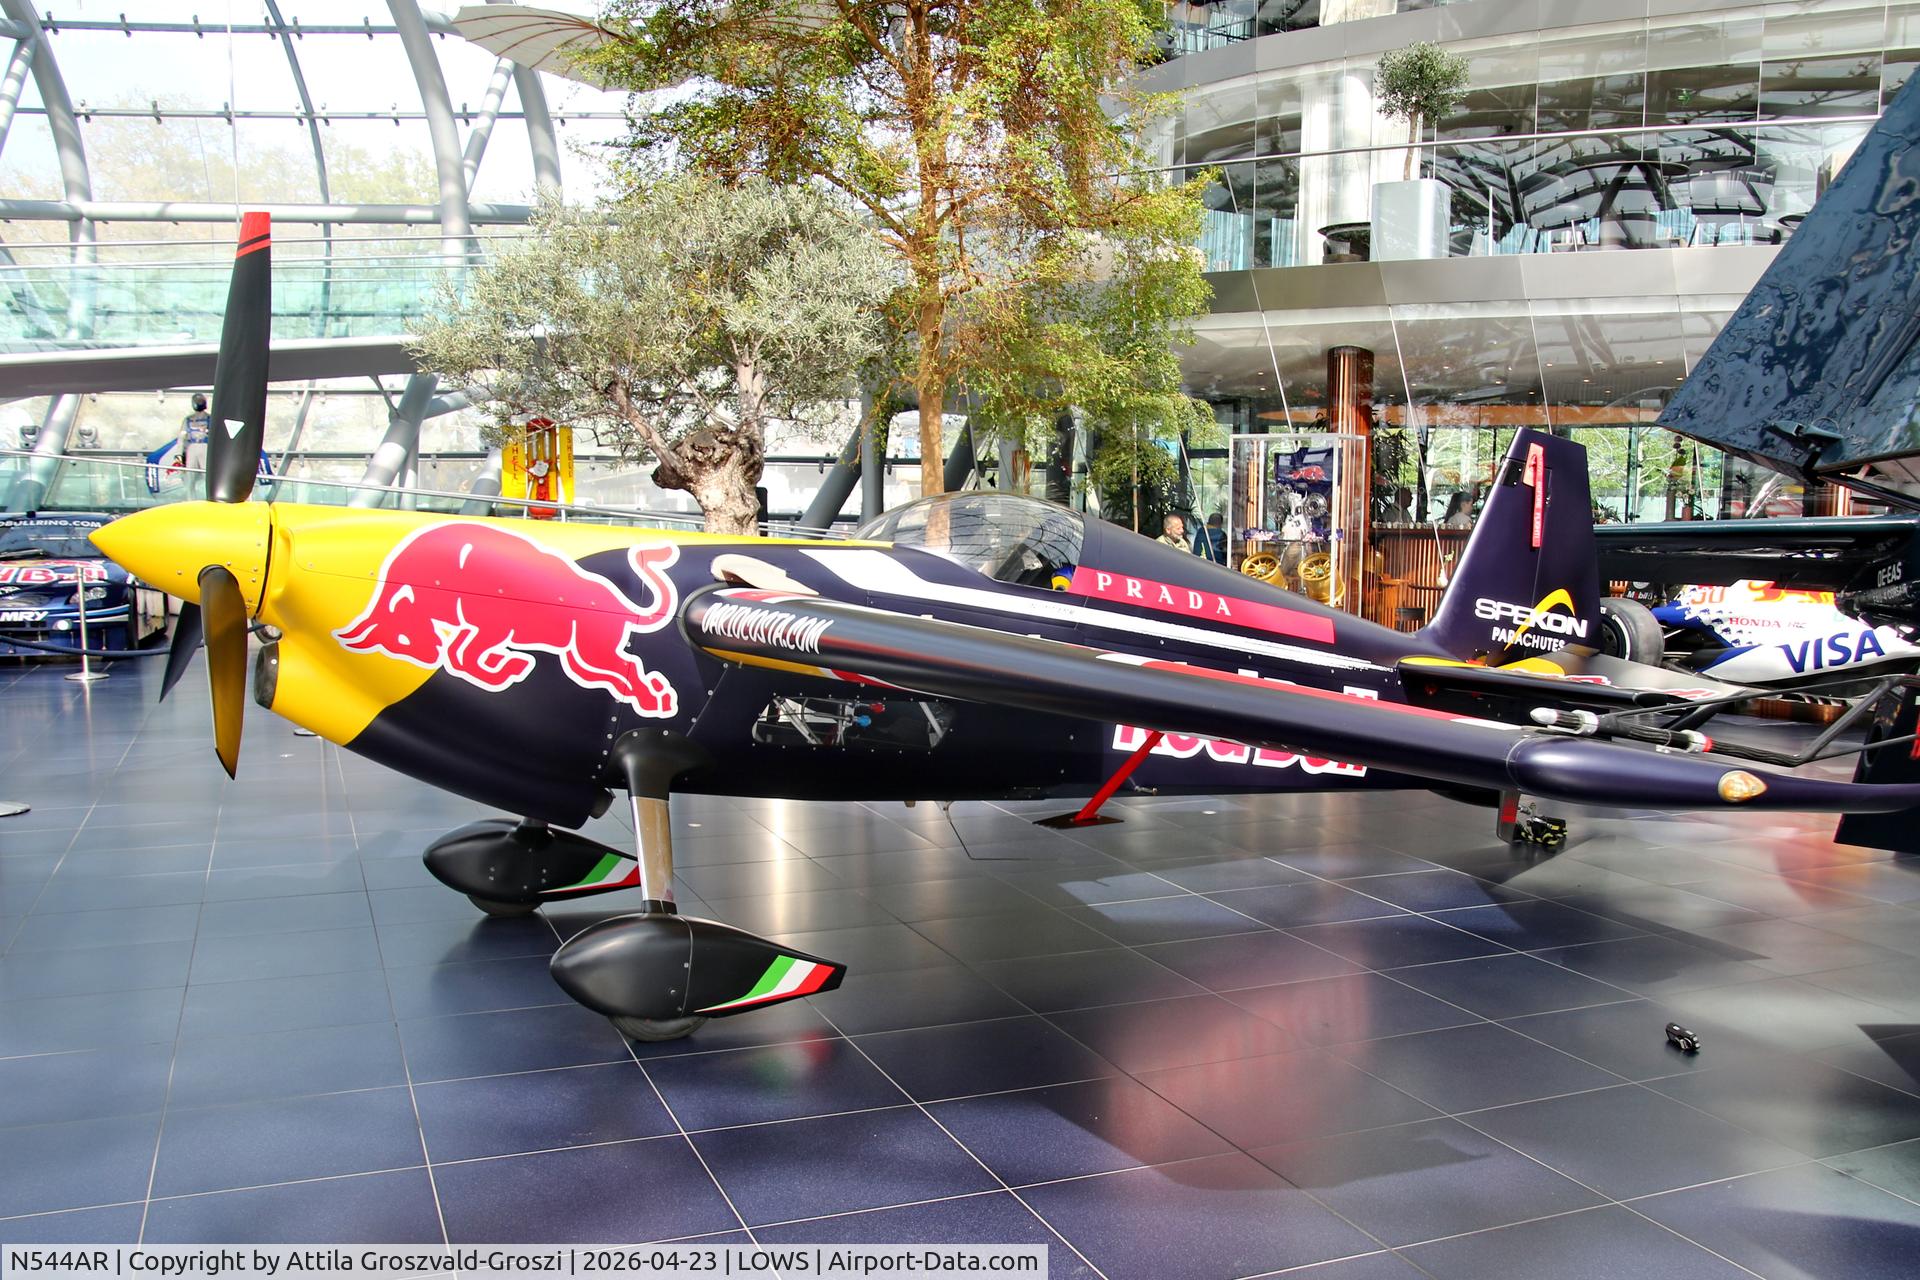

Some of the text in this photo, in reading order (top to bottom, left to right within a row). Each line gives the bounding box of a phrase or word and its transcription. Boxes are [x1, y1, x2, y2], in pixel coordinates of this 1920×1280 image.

[1097, 572, 1231, 616] PRADA
[701, 602, 834, 655] DARIOCOSTA.COM
[1475, 598, 1588, 638] SPEKON
[1492, 626, 1566, 652] PARACHUTES
[1729, 617, 1781, 629] HONDA
[1775, 629, 1886, 673] VISA
